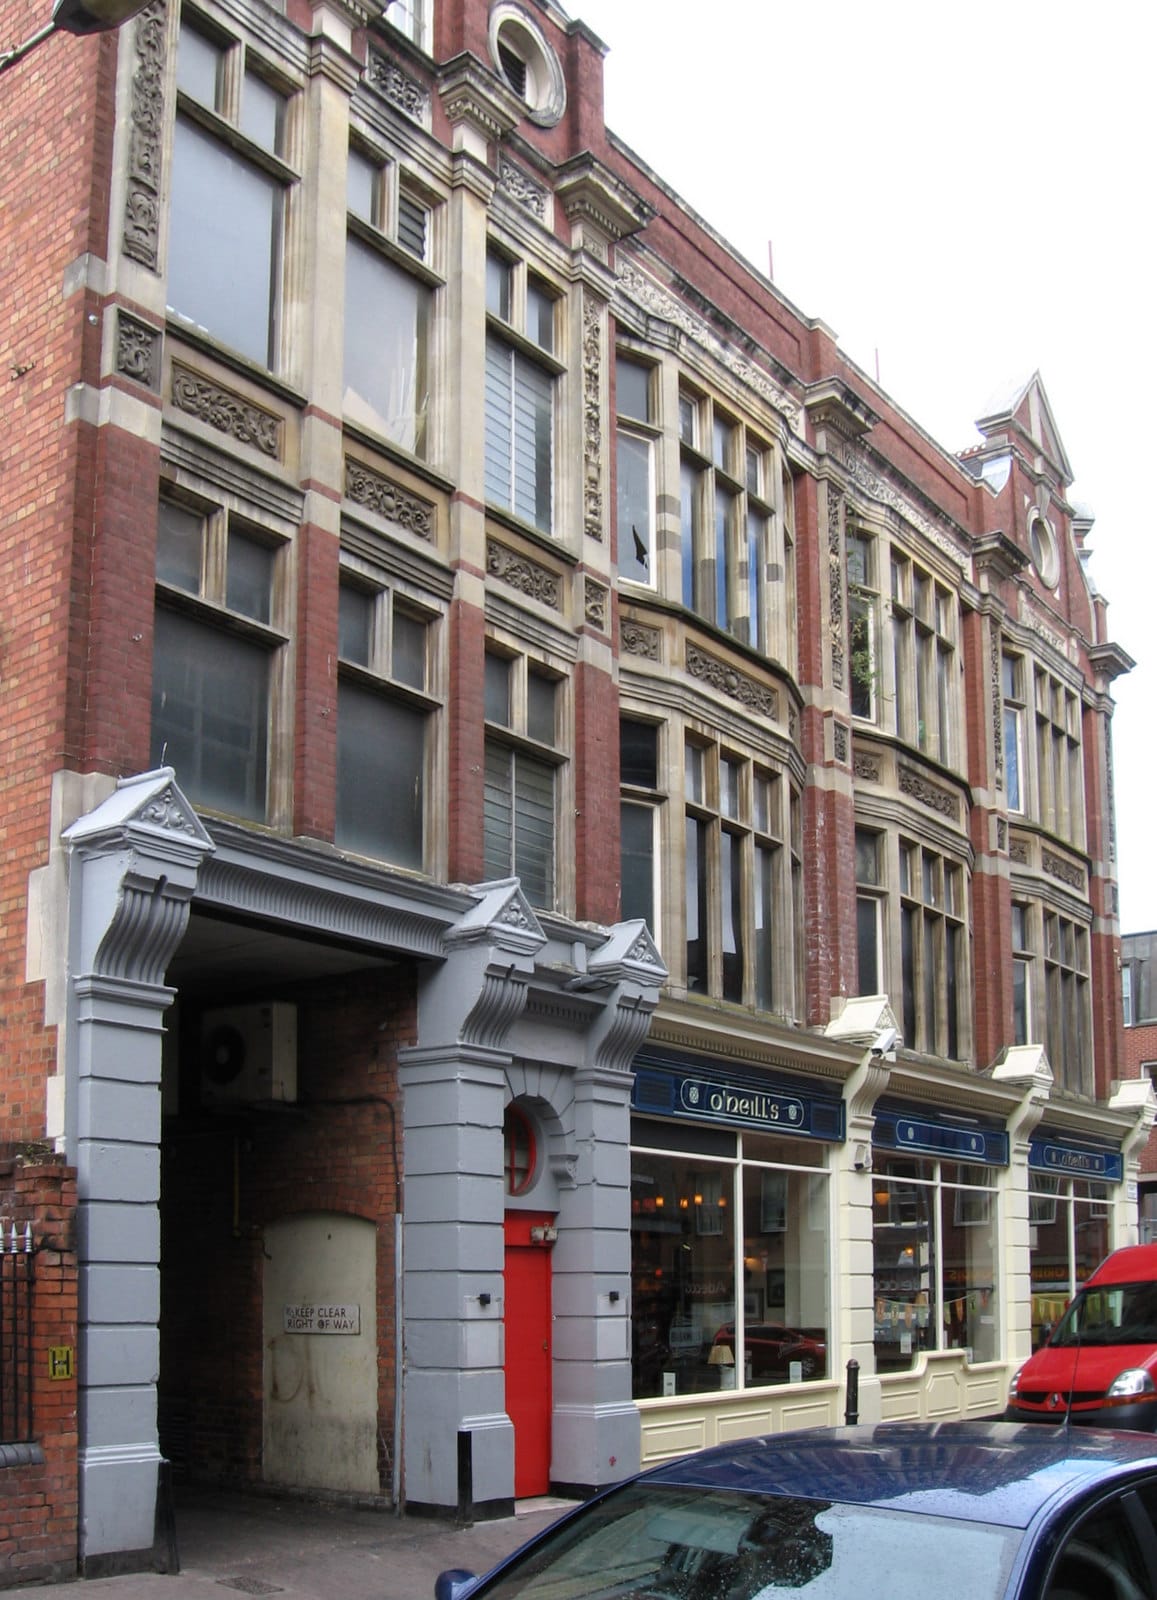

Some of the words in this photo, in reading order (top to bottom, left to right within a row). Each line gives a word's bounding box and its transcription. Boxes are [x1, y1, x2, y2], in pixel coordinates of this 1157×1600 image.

[710, 1089, 779, 1120] o'neill's
[296, 1307, 314, 1317] KEEP
[318, 1308, 346, 1318] CLEAR
[288, 1319, 313, 1329] RIGHT
[318, 1319, 330, 1329] OF
[333, 1319, 354, 1329] WAY
[52, 1350, 70, 1377] H
